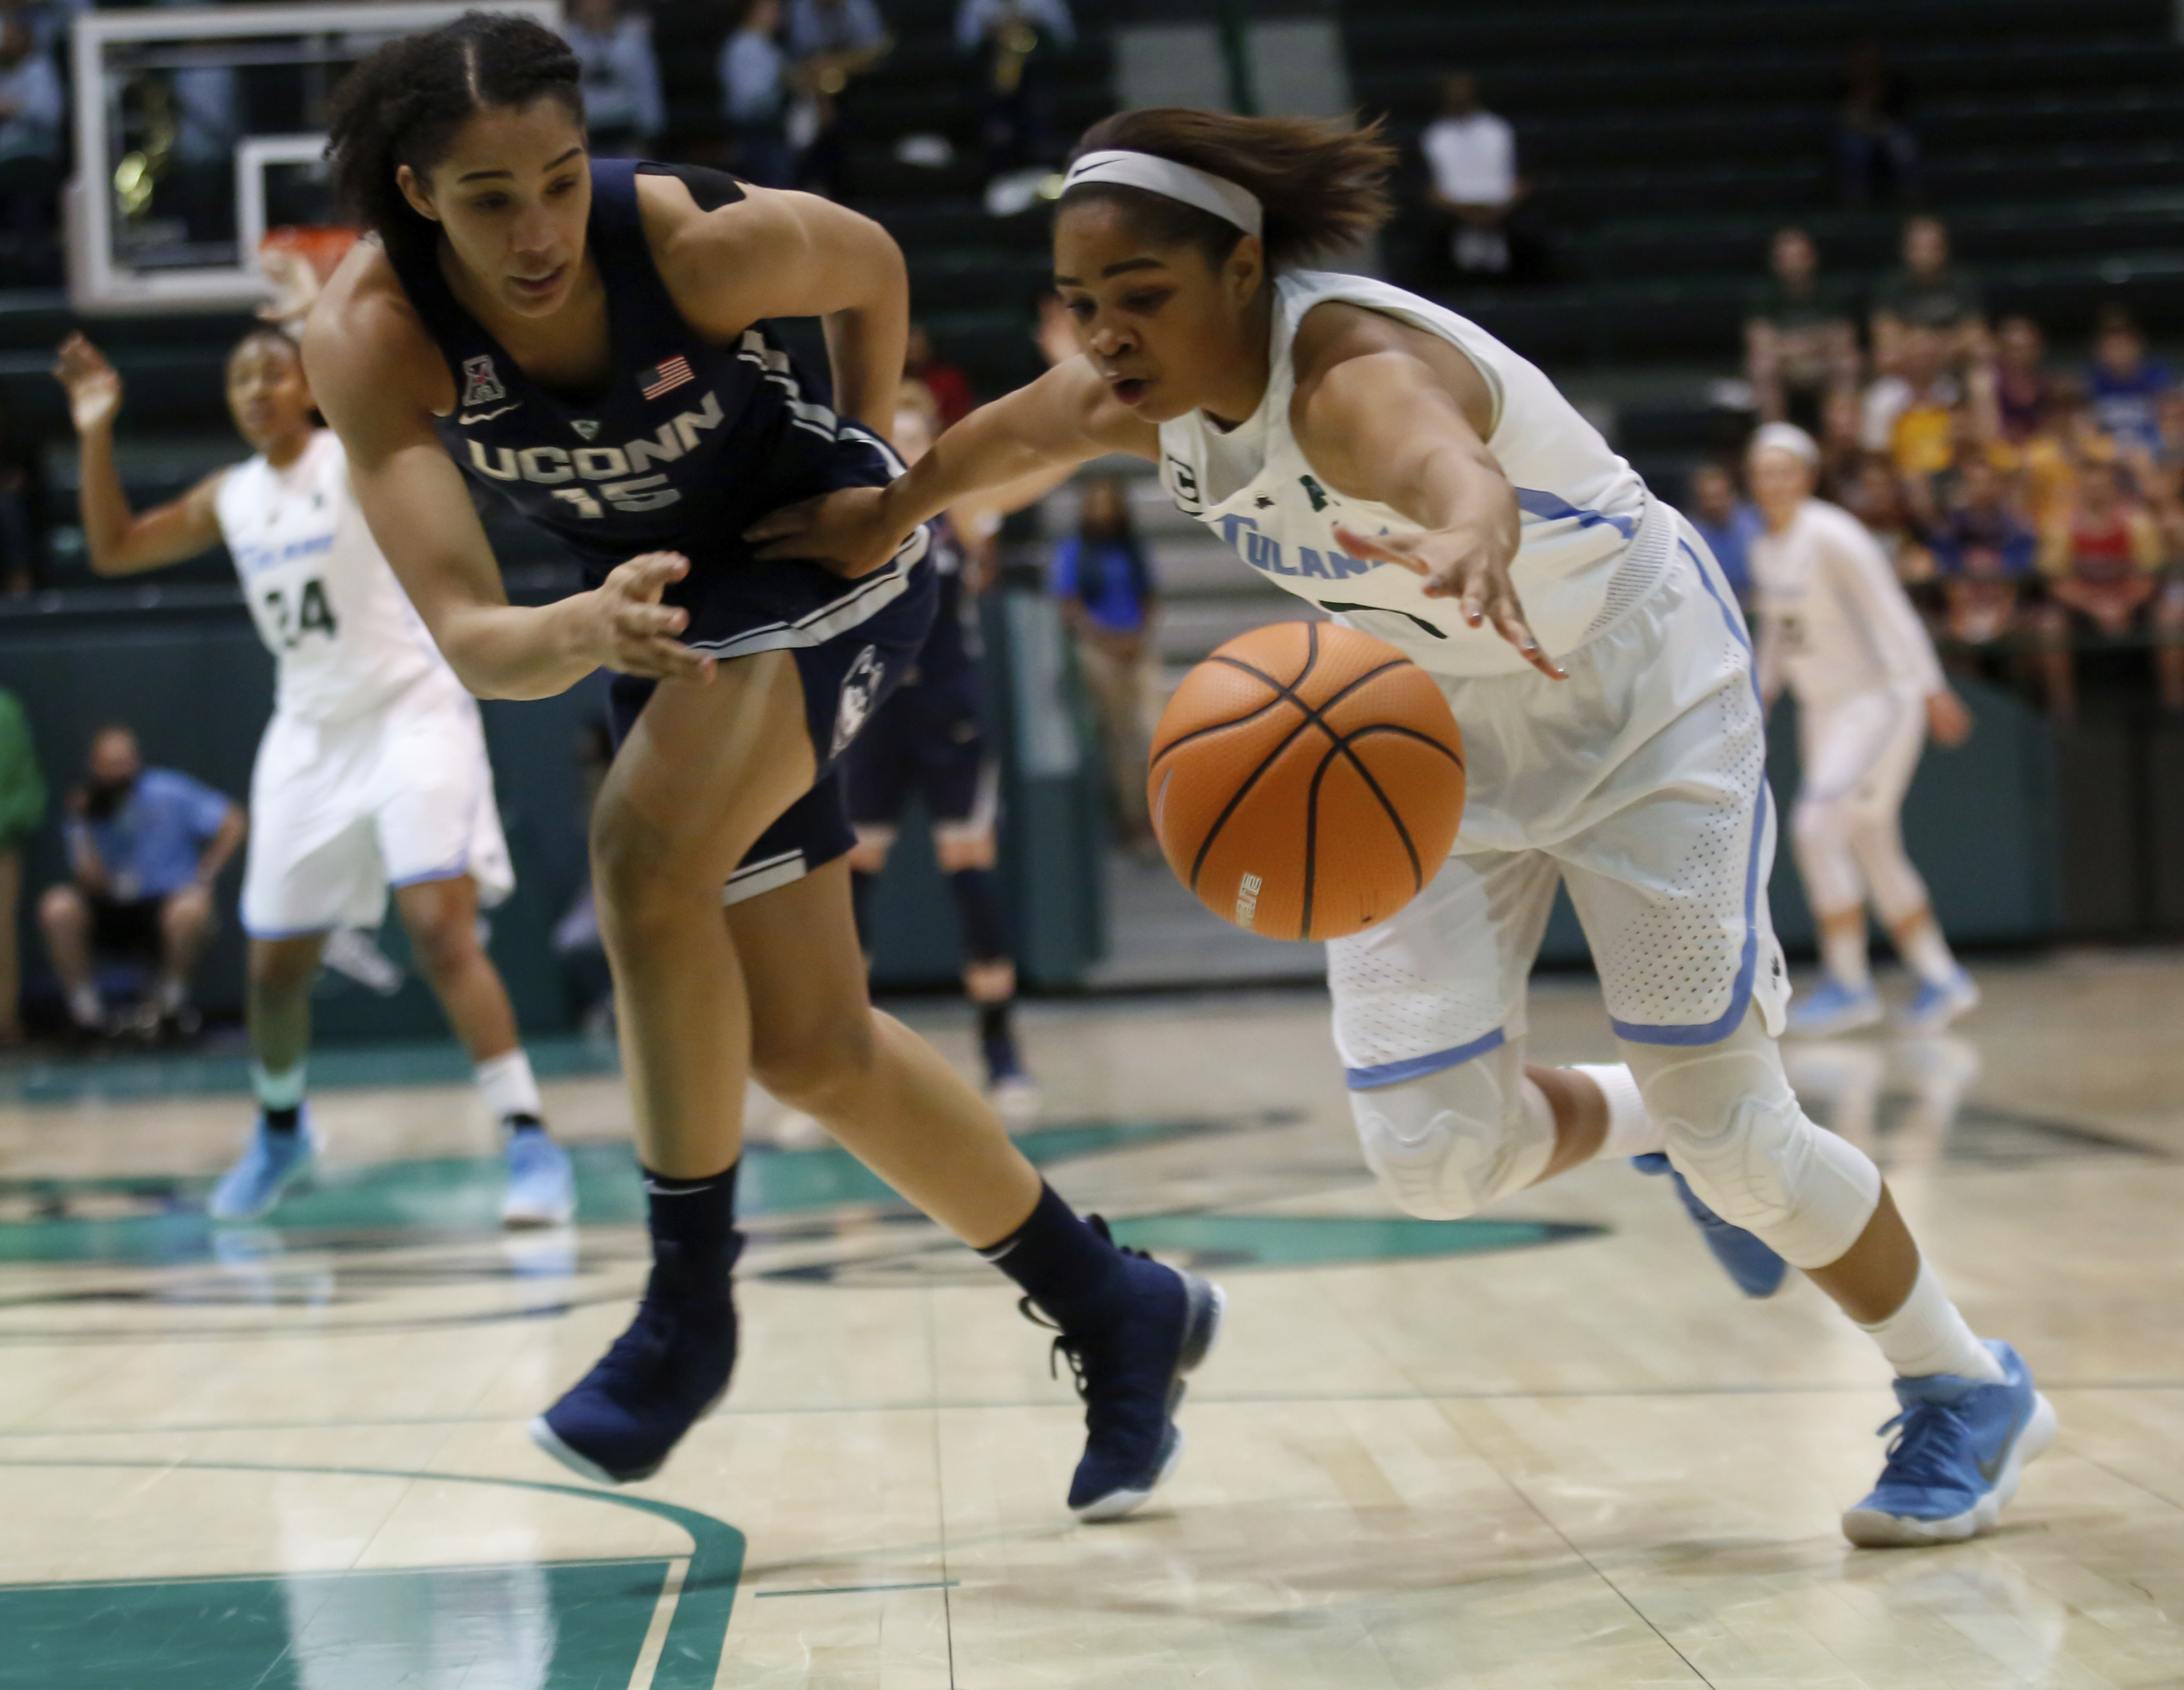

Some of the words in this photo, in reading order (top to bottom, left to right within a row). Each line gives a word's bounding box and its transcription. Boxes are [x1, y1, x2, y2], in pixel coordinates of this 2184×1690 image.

[466, 391, 725, 484] UCONN
[551, 474, 682, 518] 15
[1214, 514, 1389, 579] TULAN
[265, 579, 340, 649] 24
